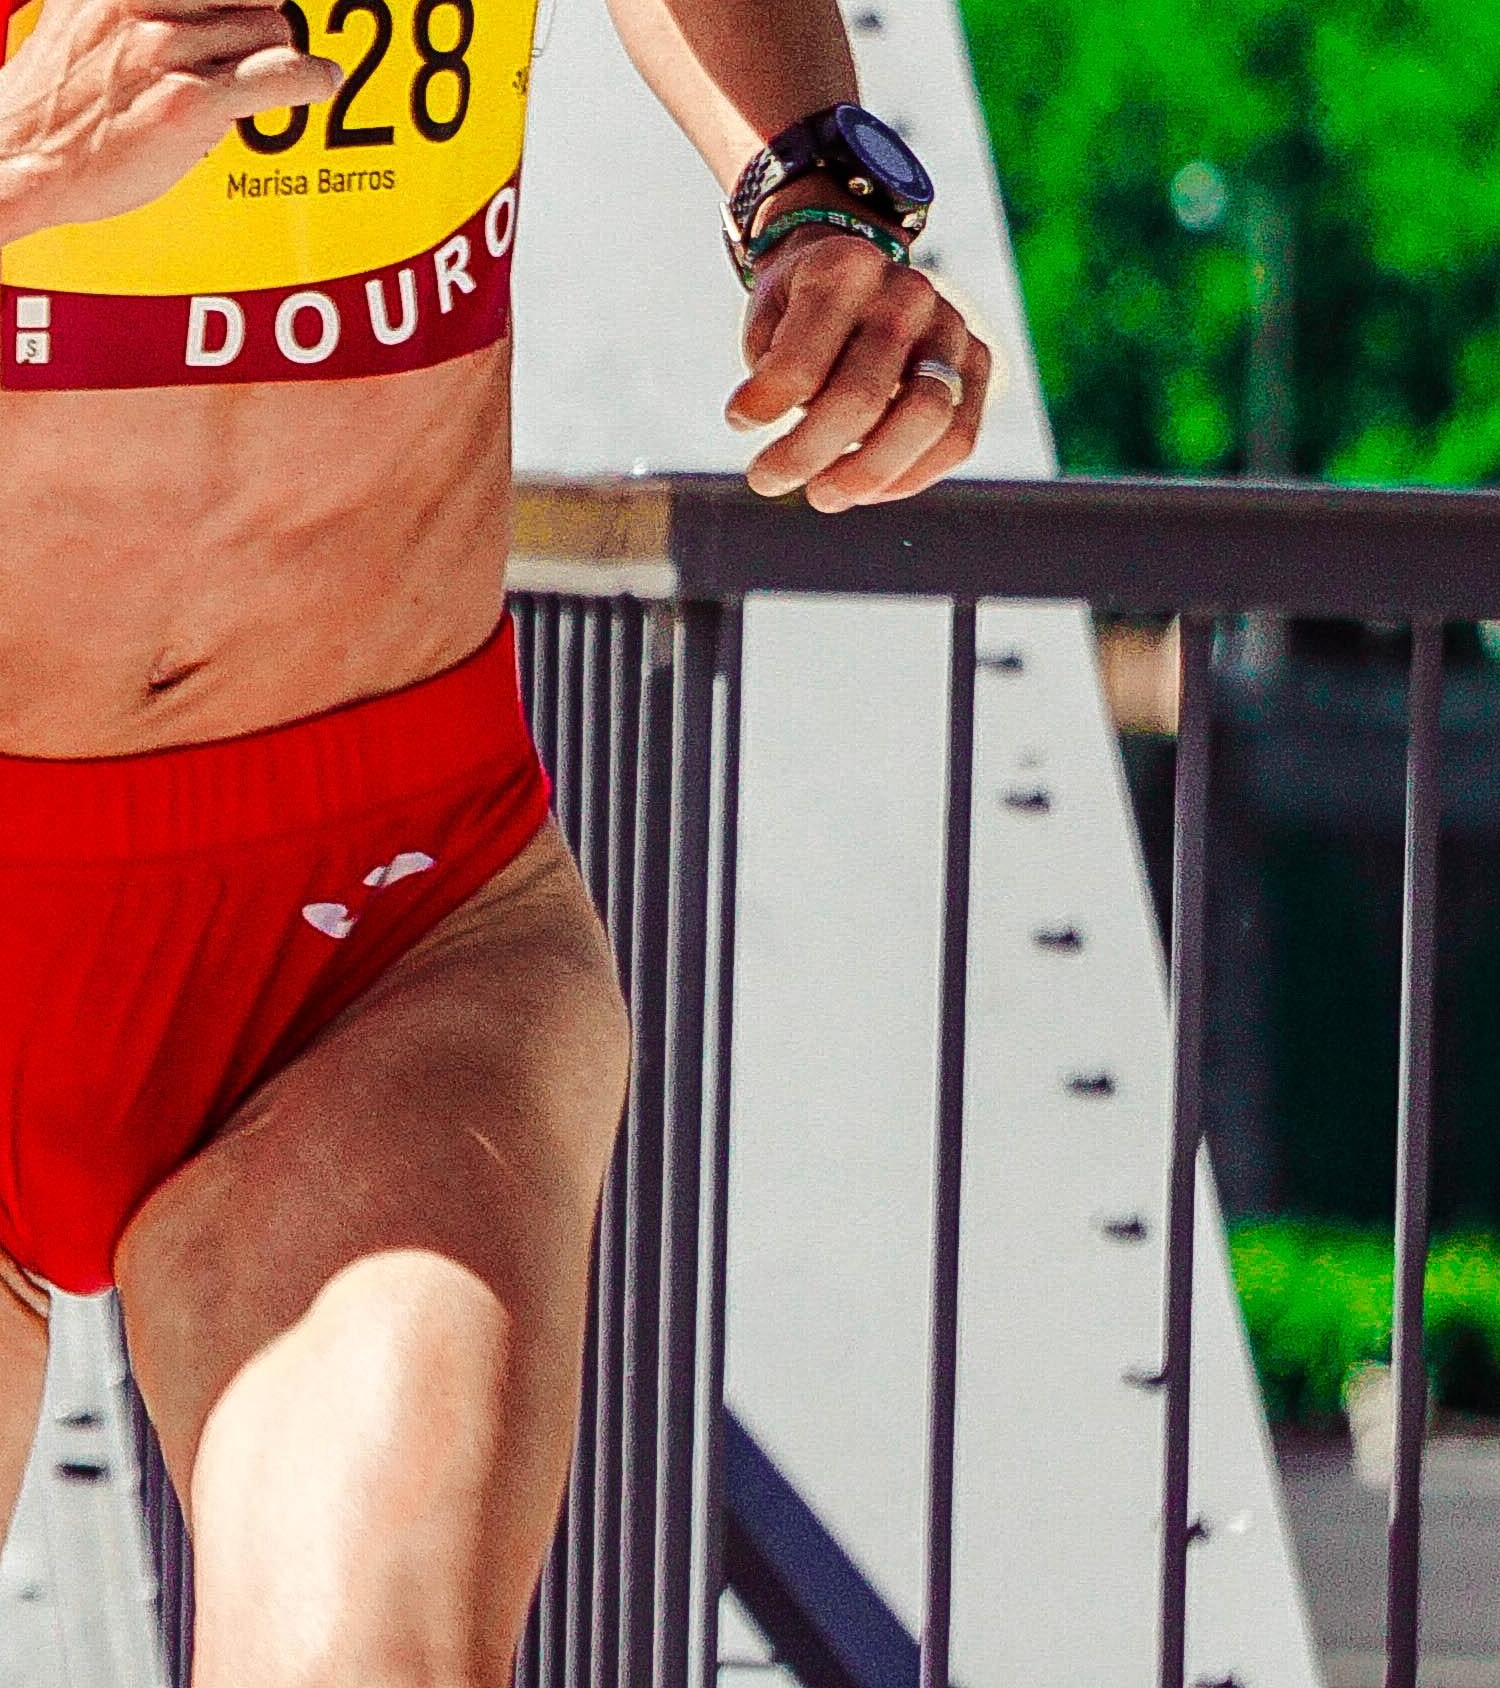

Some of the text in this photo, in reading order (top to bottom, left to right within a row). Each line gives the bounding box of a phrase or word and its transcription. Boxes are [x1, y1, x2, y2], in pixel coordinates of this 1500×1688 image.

[227, 168, 396, 199] Marisa Barros
[185, 186, 517, 367] DOURO
